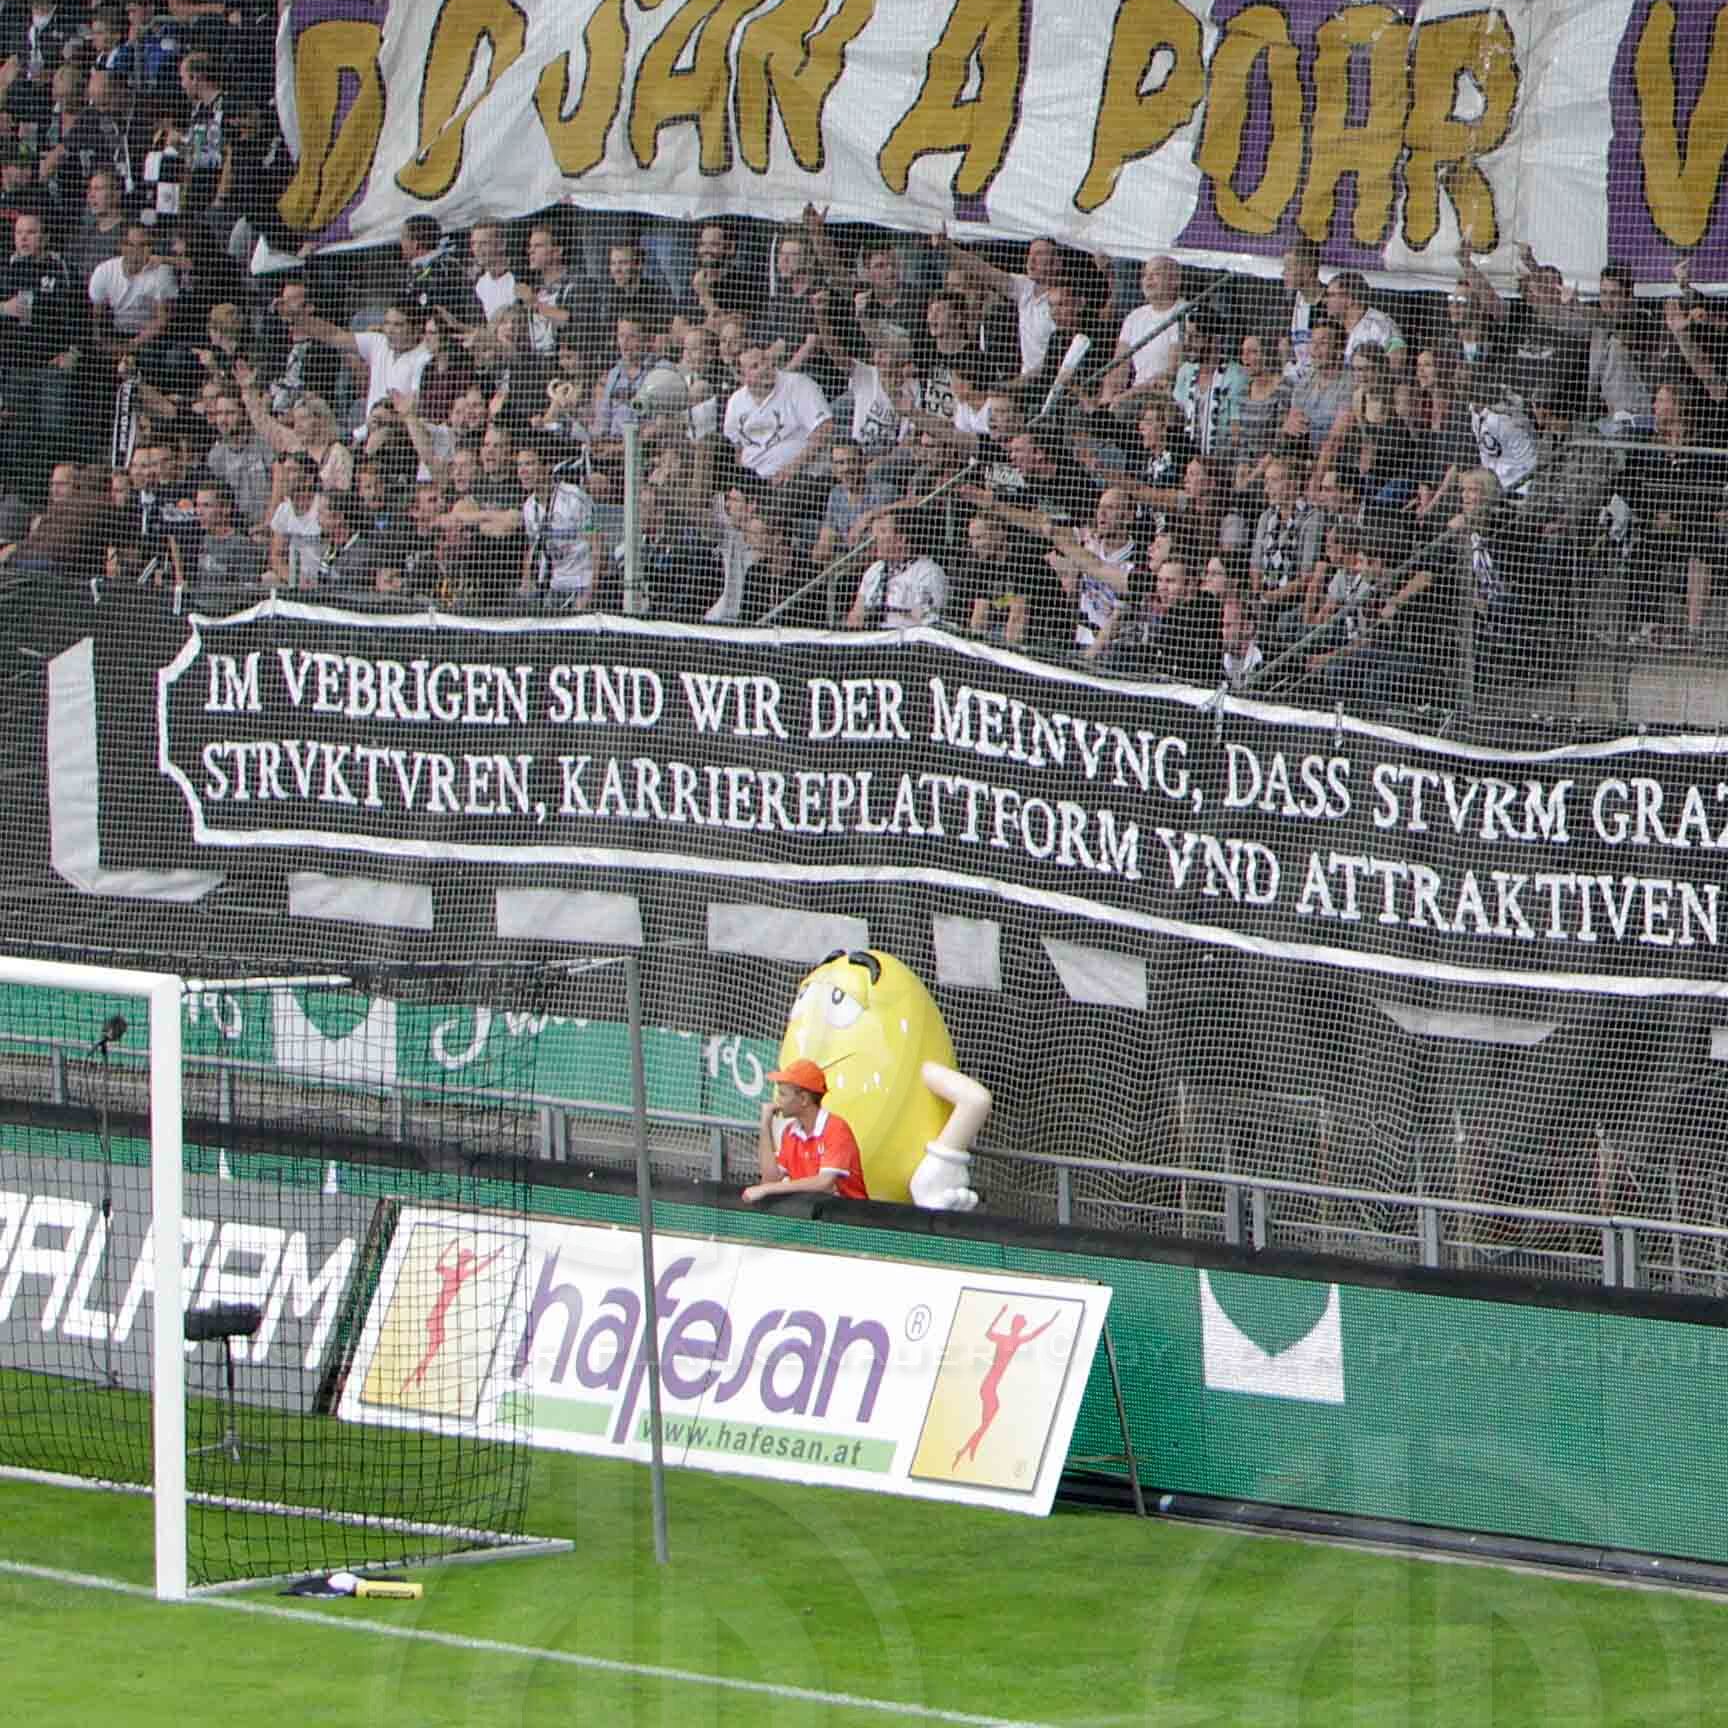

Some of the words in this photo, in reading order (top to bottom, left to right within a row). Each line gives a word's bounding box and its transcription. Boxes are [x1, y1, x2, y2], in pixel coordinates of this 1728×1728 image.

[201, 740, 548, 825] STRVKTVREN,
[558, 761, 1141, 882] KARRIEREPLATTFORM
[1155, 828, 1281, 905] VND
[1296, 850, 1721, 947] ATTRAKTIVEN
[203, 652, 263, 714] IM
[273, 648, 532, 726] VEBRIGEN
[547, 664, 664, 729] SIND
[680, 672, 788, 740] WIR
[807, 677, 906, 742] DER
[929, 676, 1204, 814] MEINVNG,
[1222, 742, 1352, 819] DASS
[1371, 764, 1574, 844] STVRM
[510, 1244, 891, 1445] hafesan
[639, 1415, 863, 1468] www.hafesan.at
